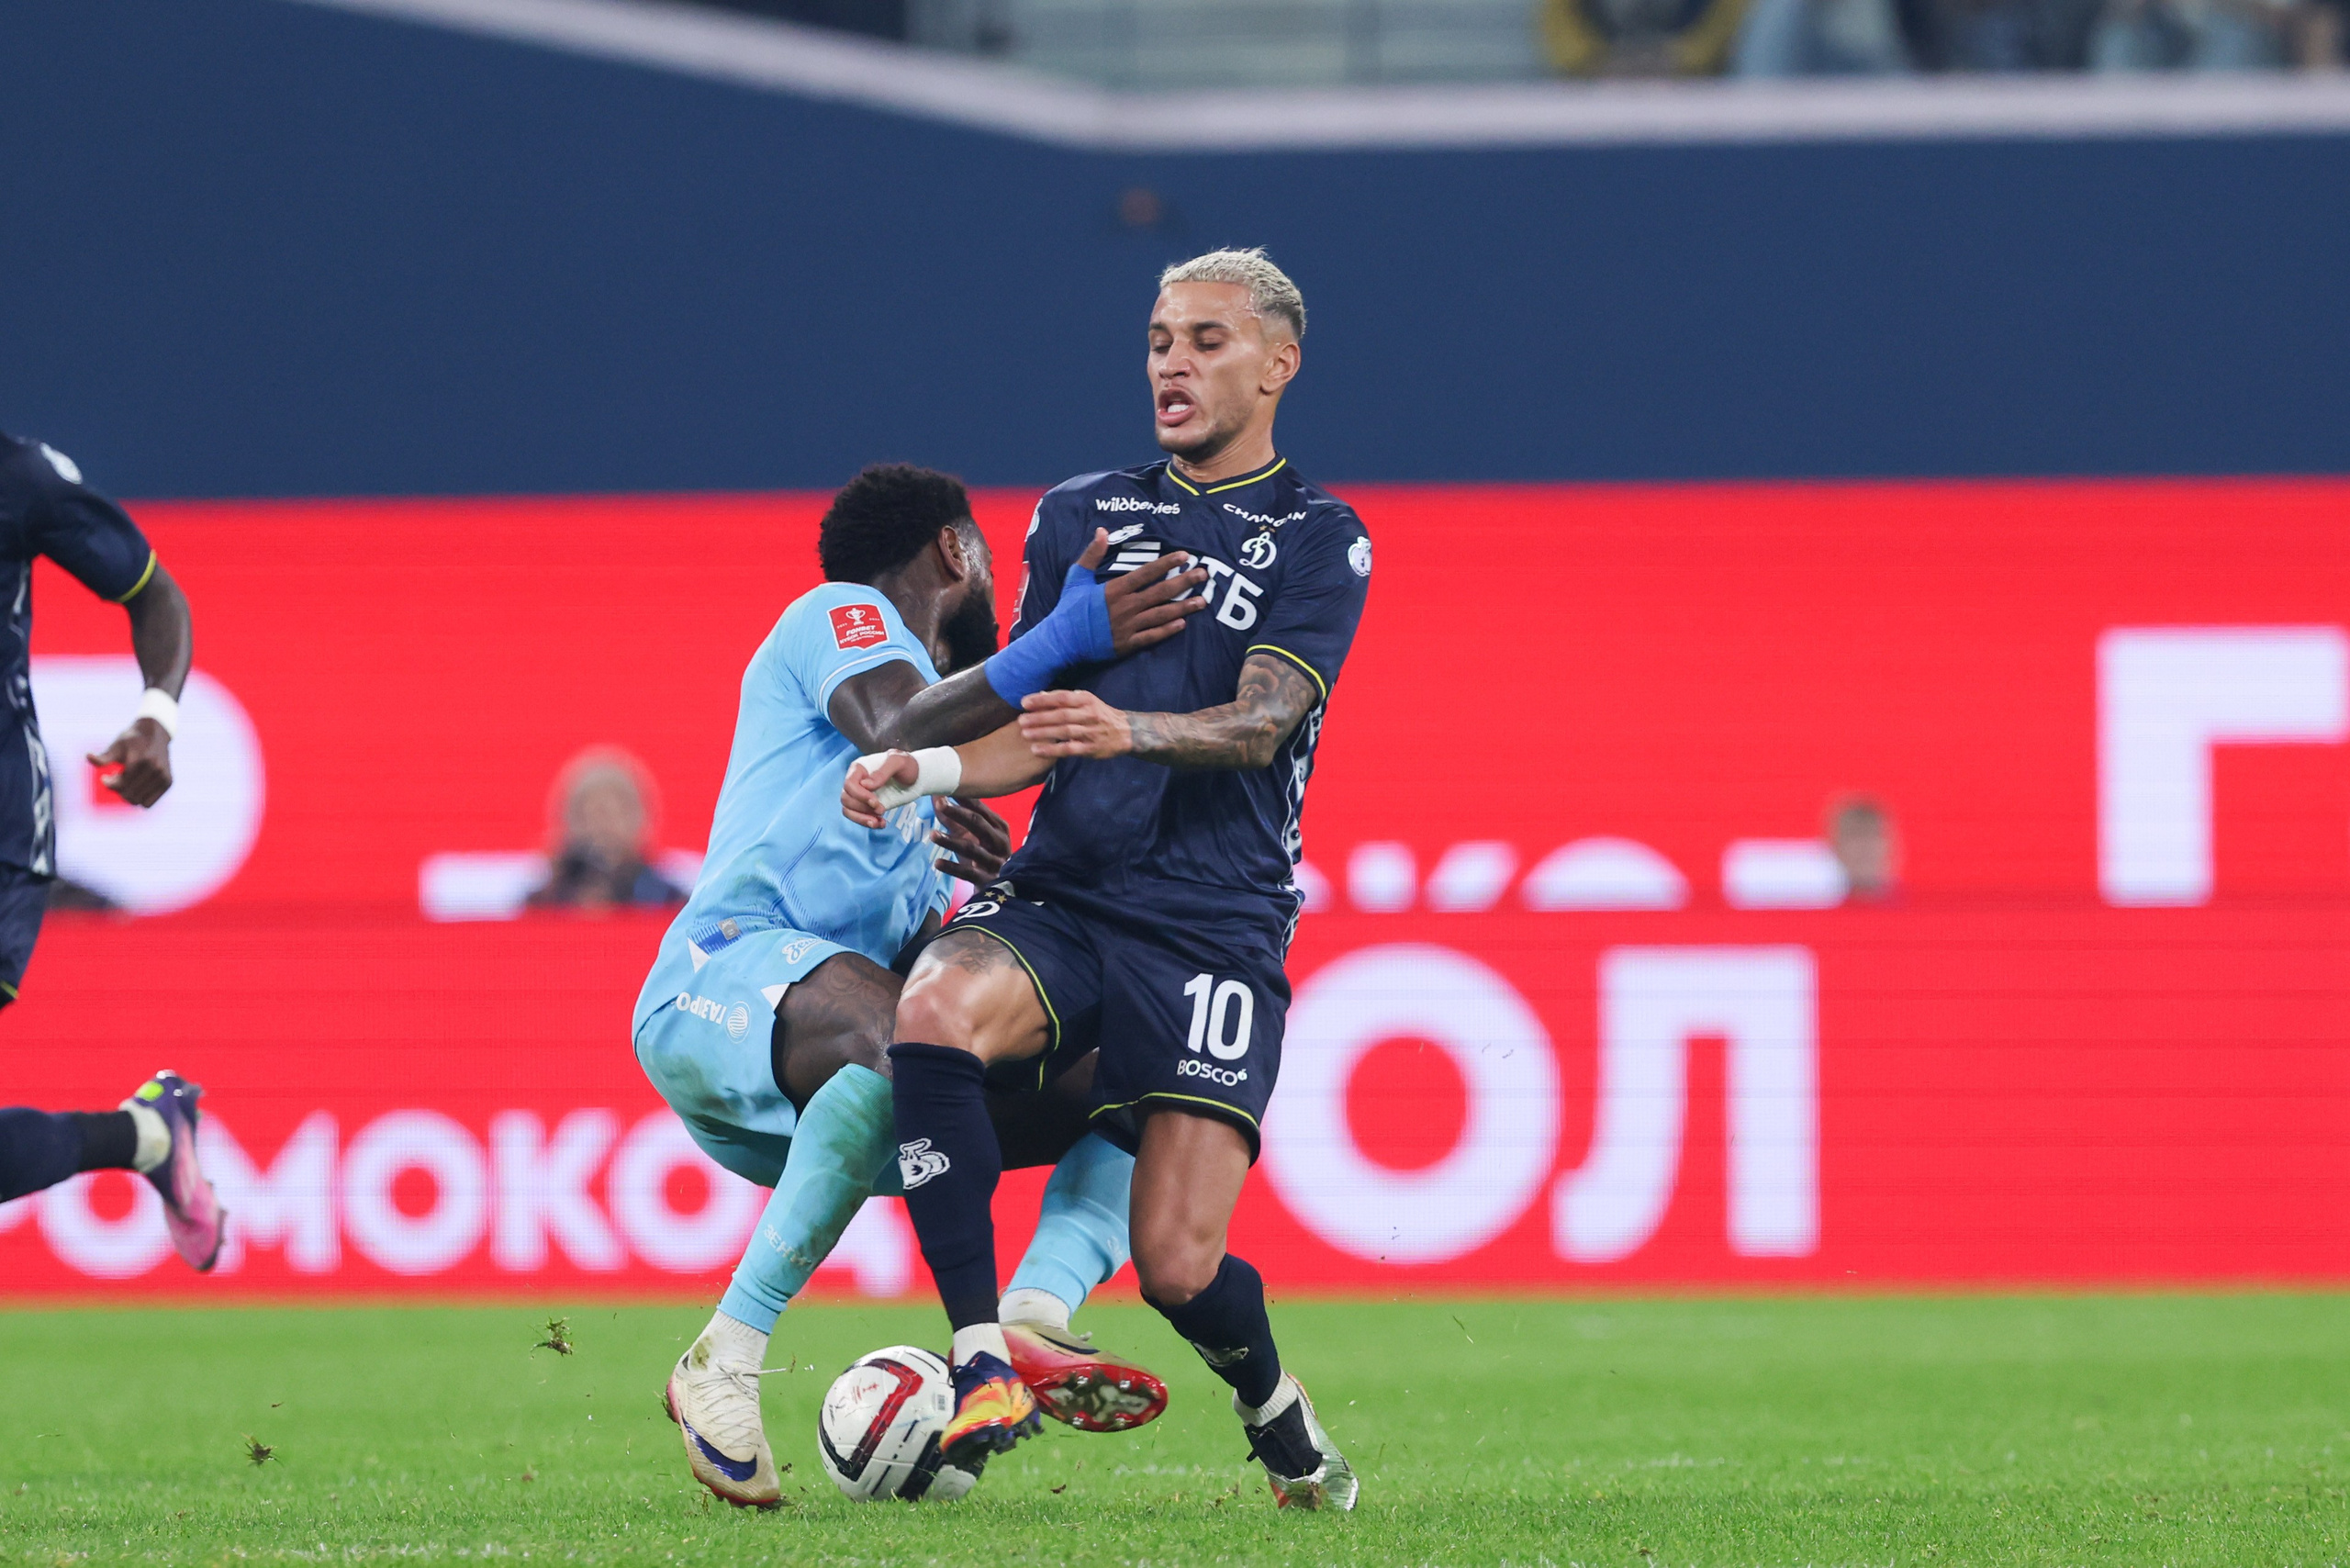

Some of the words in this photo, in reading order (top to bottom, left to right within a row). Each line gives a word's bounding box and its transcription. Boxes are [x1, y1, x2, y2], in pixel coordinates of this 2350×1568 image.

[1183, 973, 1254, 1060] 10
[1177, 1059, 1238, 1086] BOSCO
[0, 1108, 916, 1297] ОМОКО
